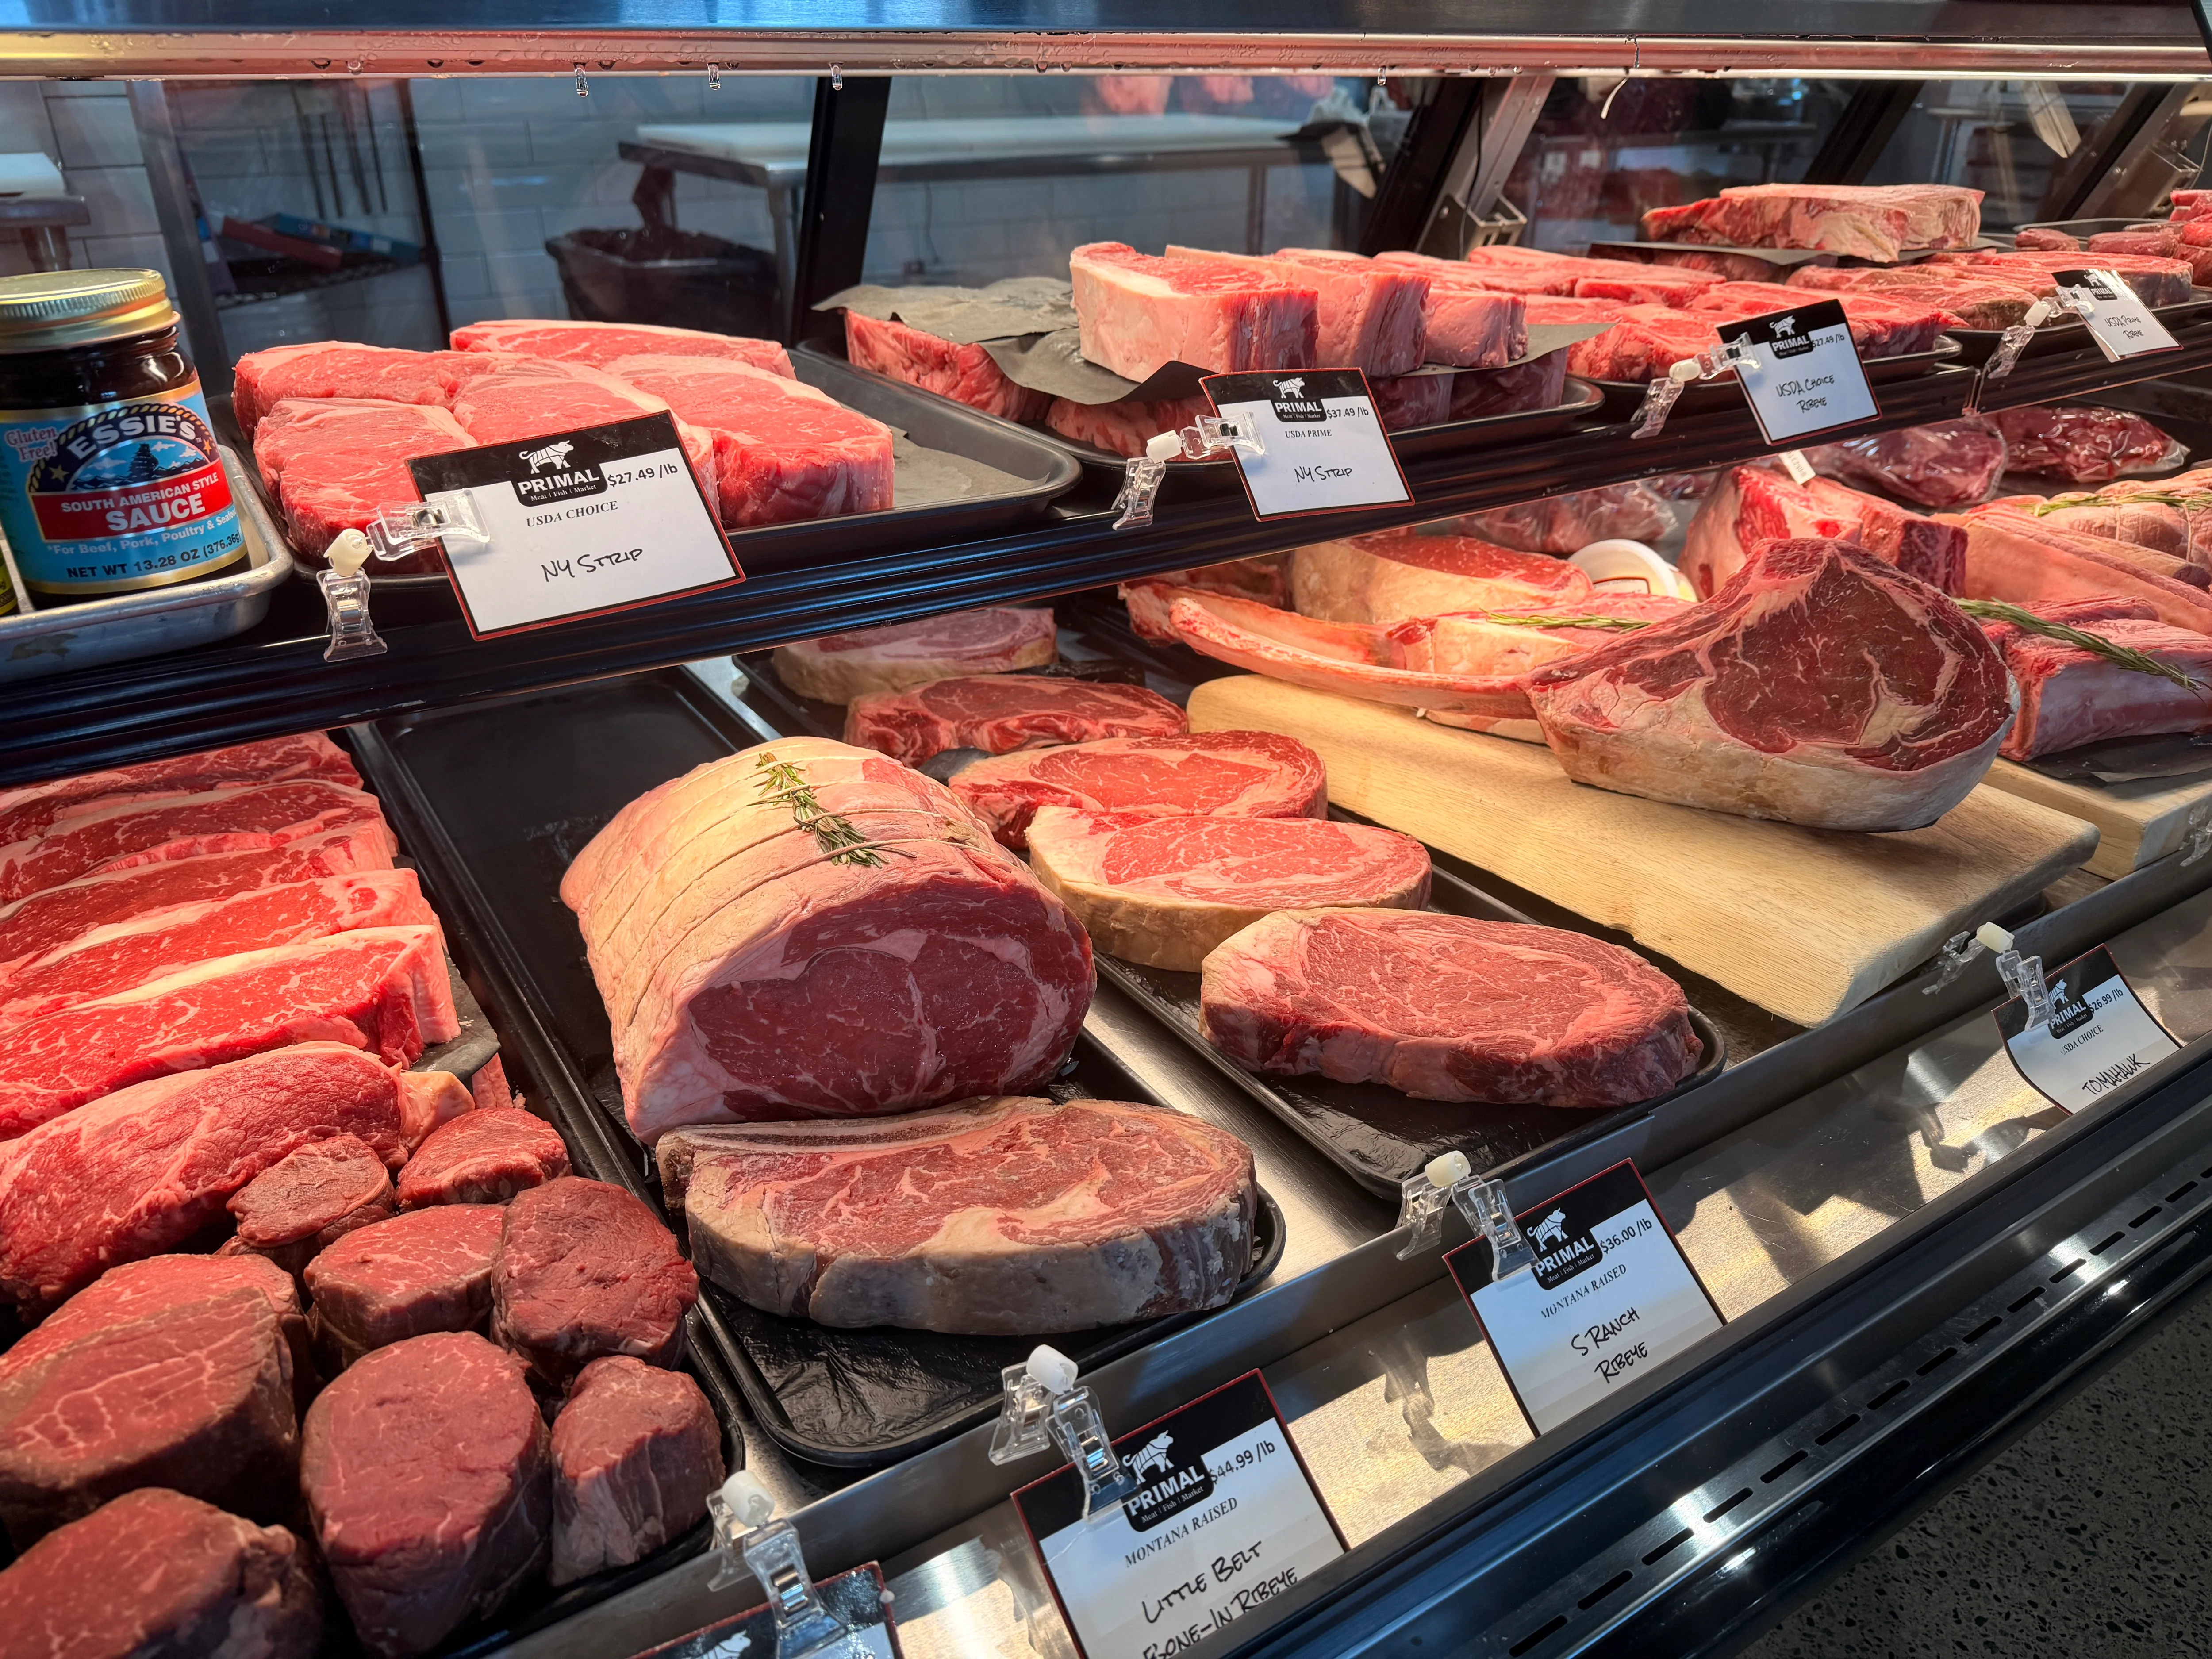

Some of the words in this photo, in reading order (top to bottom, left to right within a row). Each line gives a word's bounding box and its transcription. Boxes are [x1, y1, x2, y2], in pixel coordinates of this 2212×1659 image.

[2104, 316, 2125, 327] USDA
[1771, 335, 1810, 352] PRIMAL
[1812, 336, 1834, 347] $27.49
[1835, 333, 1845, 343] /lb
[1775, 380, 1806, 397] USDA
[1805, 375, 1835, 391] CHOICE
[1274, 402, 1322, 412] PRIMAL
[1327, 408, 1355, 419] $37.49
[1357, 407, 1369, 418] /lb
[1797, 397, 1827, 413] RIBEYE
[5, 427, 57, 446] Gluten
[67, 414, 197, 460] ESSIE'S
[18, 444, 57, 461] Free!
[518, 469, 600, 495] PRIMAL
[574, 484, 597, 493] Market
[607, 467, 655, 488] $27.49
[659, 463, 678, 478] /lb
[1294, 465, 1315, 483] NY
[1314, 465, 1353, 481] STRIP
[61, 497, 118, 512] SOUTH
[119, 483, 191, 507] AMERICAN
[192, 472, 219, 490] STYLE
[106, 492, 205, 531] SAUCE
[526, 512, 563, 527] USDA
[566, 500, 618, 519] CHOICE
[79, 541, 117, 553] Beef,
[120, 536, 158, 550] Pork,
[162, 525, 204, 542] Poultry
[207, 520, 215, 530] &
[66, 566, 97, 578] NET
[102, 563, 127, 575] WT
[134, 555, 176, 572] 13.28
[180, 548, 200, 562] OZ
[541, 559, 576, 582] NY
[576, 548, 643, 573] STRIP
[2050, 1001, 2086, 1029] PRIMAL
[2088, 993, 2112, 1014] $26.99
[2112, 988, 2124, 1001] /lb
[2076, 1013, 2088, 1022] Market
[2078, 1024, 2104, 1044] CHOICE
[2081, 1053, 2151, 1095] TOMAHAWK
[1600, 1225, 1636, 1255] $36.00
[1636, 1218, 1653, 1236] /lb
[1534, 1237, 1594, 1278] PRIMAL
[1547, 1273, 1560, 1283] Meat
[1563, 1264, 1575, 1275] Fish
[1577, 1254, 1595, 1266] Market
[1540, 1285, 1590, 1319] MONTANA
[1590, 1264, 1626, 1291] RAISED
[1585, 1306, 1641, 1350] RANCH
[1594, 1341, 1648, 1384] RIBEYE
[1209, 1449, 1254, 1485] $44.99
[1256, 1440, 1276, 1463] /lb
[1126, 1465, 1205, 1517] PRIMAL
[1141, 1509, 1159, 1524] Meat
[1162, 1498, 1177, 1513] Fish
[1182, 1486, 1204, 1502] Market
[1125, 1523, 1190, 1568] MONTANA
[1191, 1497, 1238, 1531] RAISED
[1142, 1572, 1207, 1624] LITTLE
[1211, 1540, 1262, 1583] BELT
[1142, 1606, 1233, 1659] BONE-IN
[1230, 1567, 1298, 1614] RIBEYE
